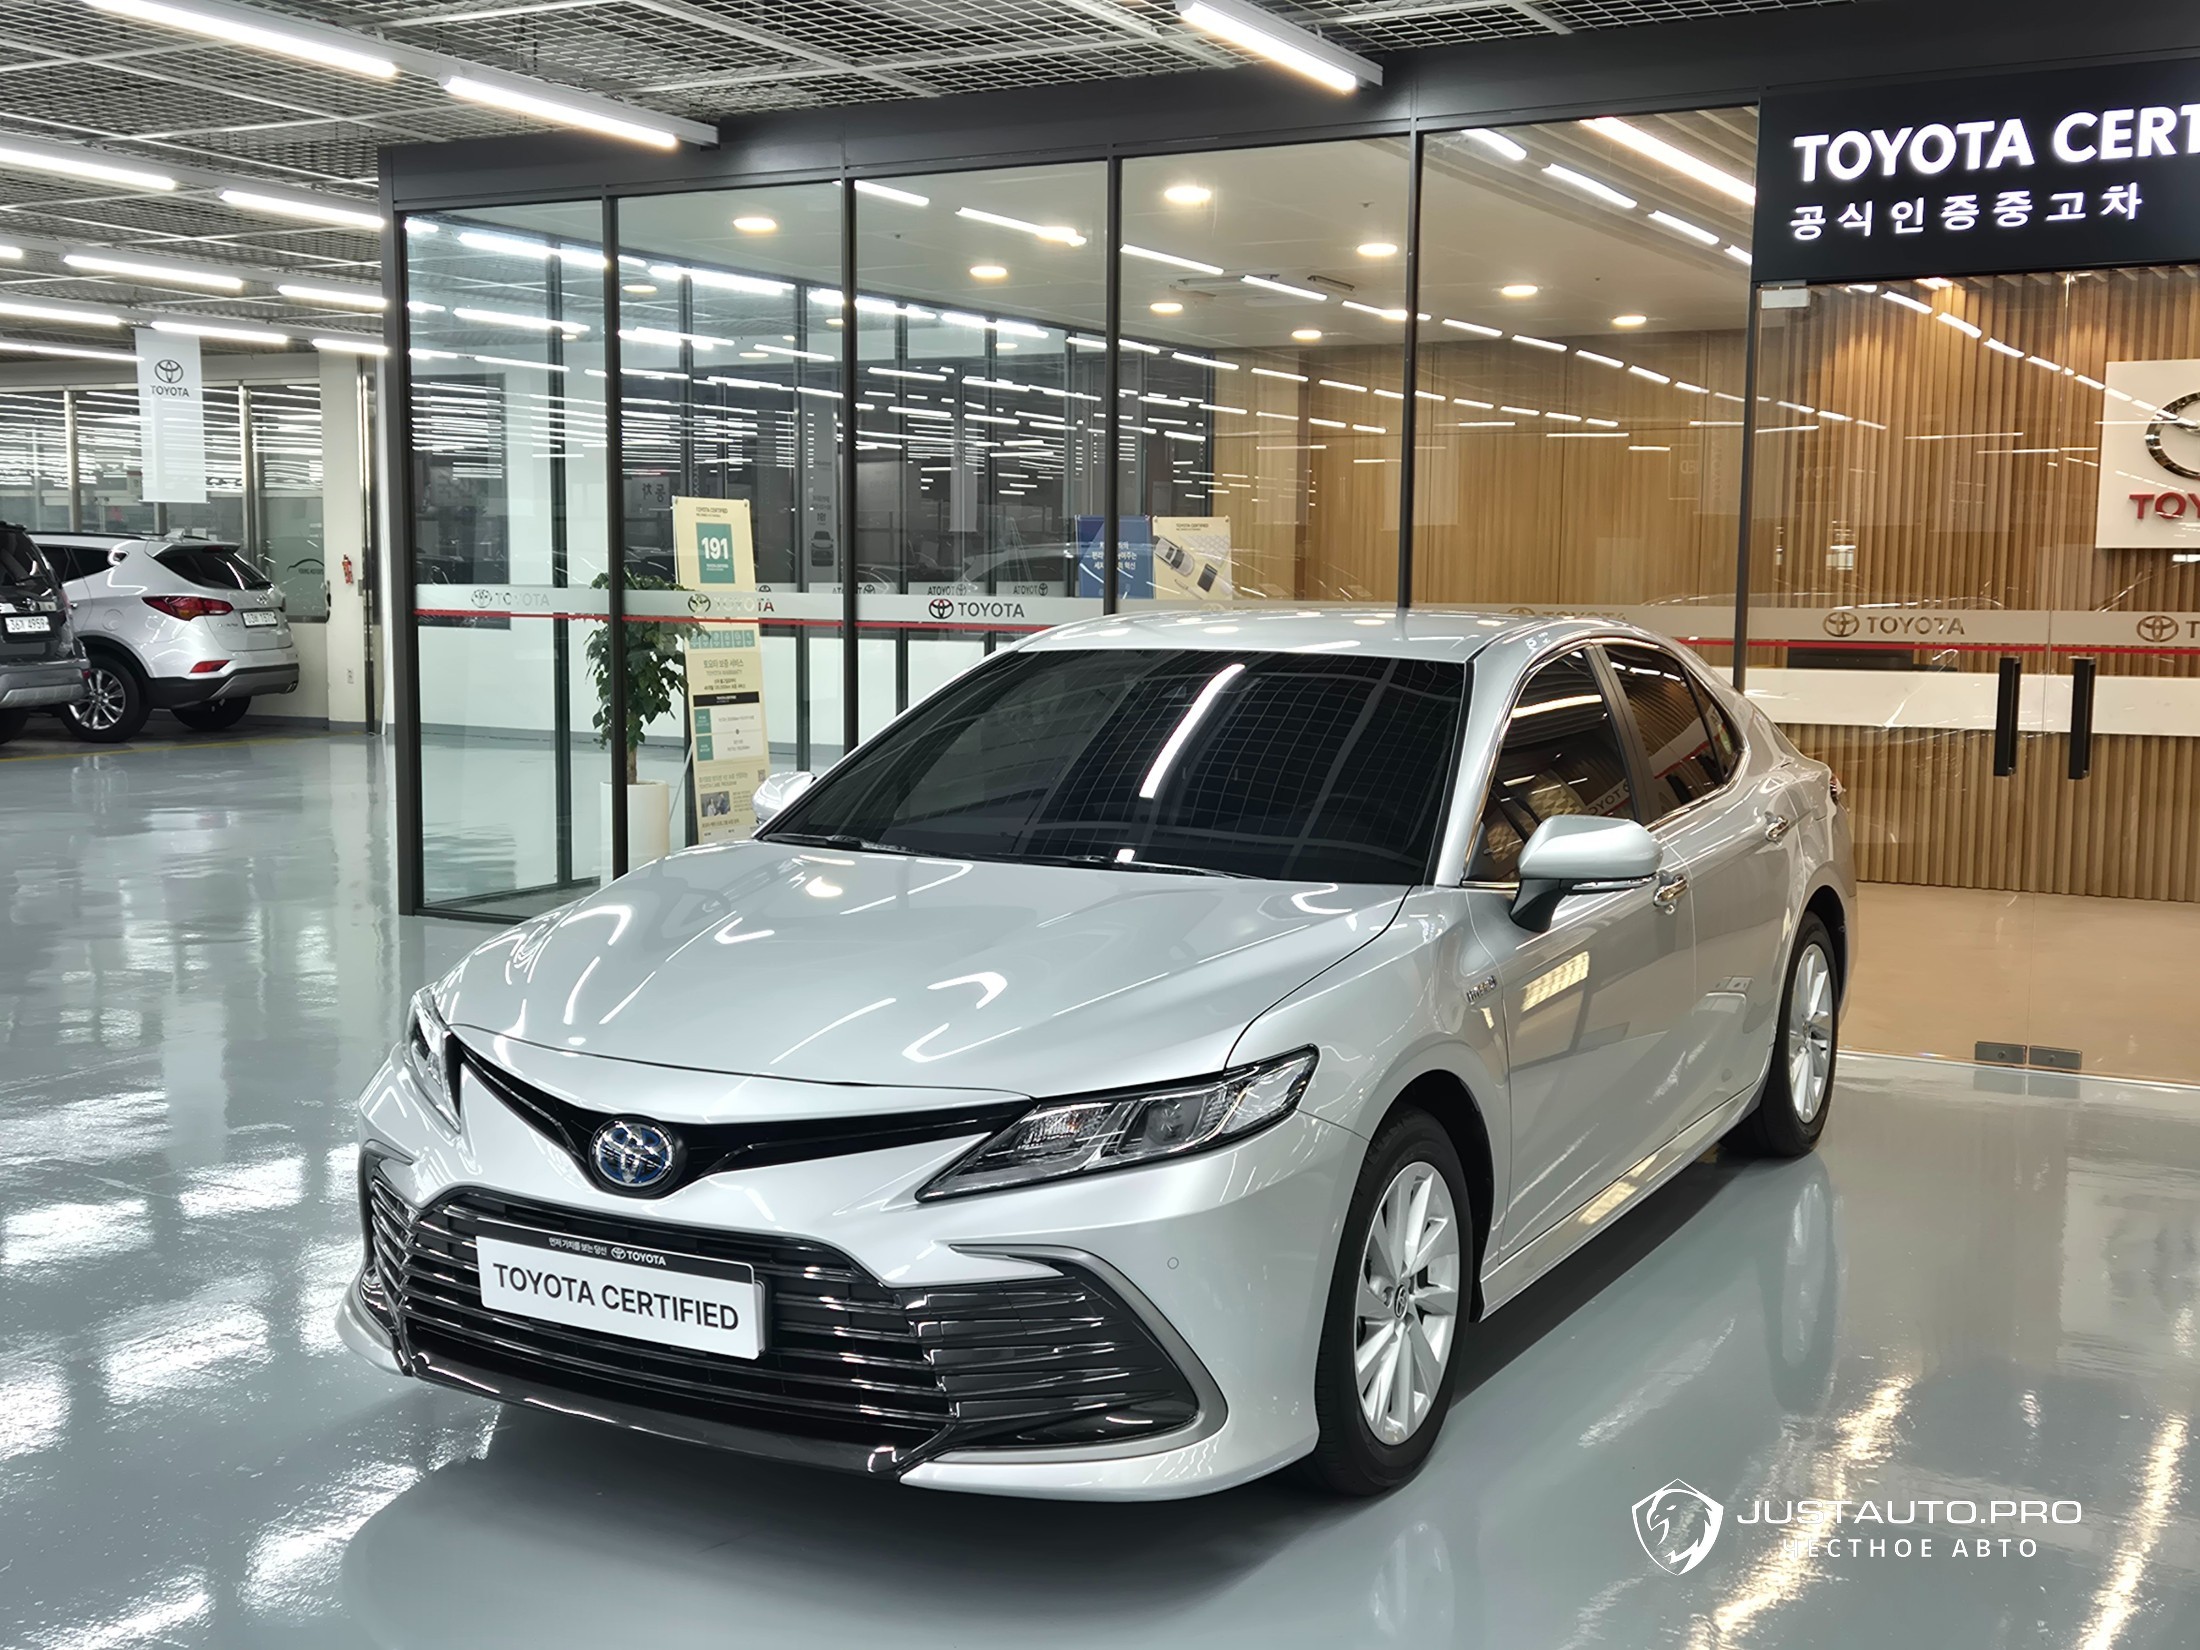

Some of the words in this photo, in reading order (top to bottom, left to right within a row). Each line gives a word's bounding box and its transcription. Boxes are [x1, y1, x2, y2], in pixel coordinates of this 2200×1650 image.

[1793, 118, 2035, 182] TOYOTA
[2053, 103, 2200, 163] CERT
[150, 384, 190, 398] TOYOTA
[701, 537, 729, 559] 191
[495, 592, 550, 606] TOYOTA
[958, 602, 1024, 617] TOYOTA
[1866, 616, 1965, 636] TOYOTA
[626, 1250, 667, 1266] TOYOTA
[493, 1262, 595, 1306] TOYOTA
[601, 1284, 739, 1331] CERTIFIED
